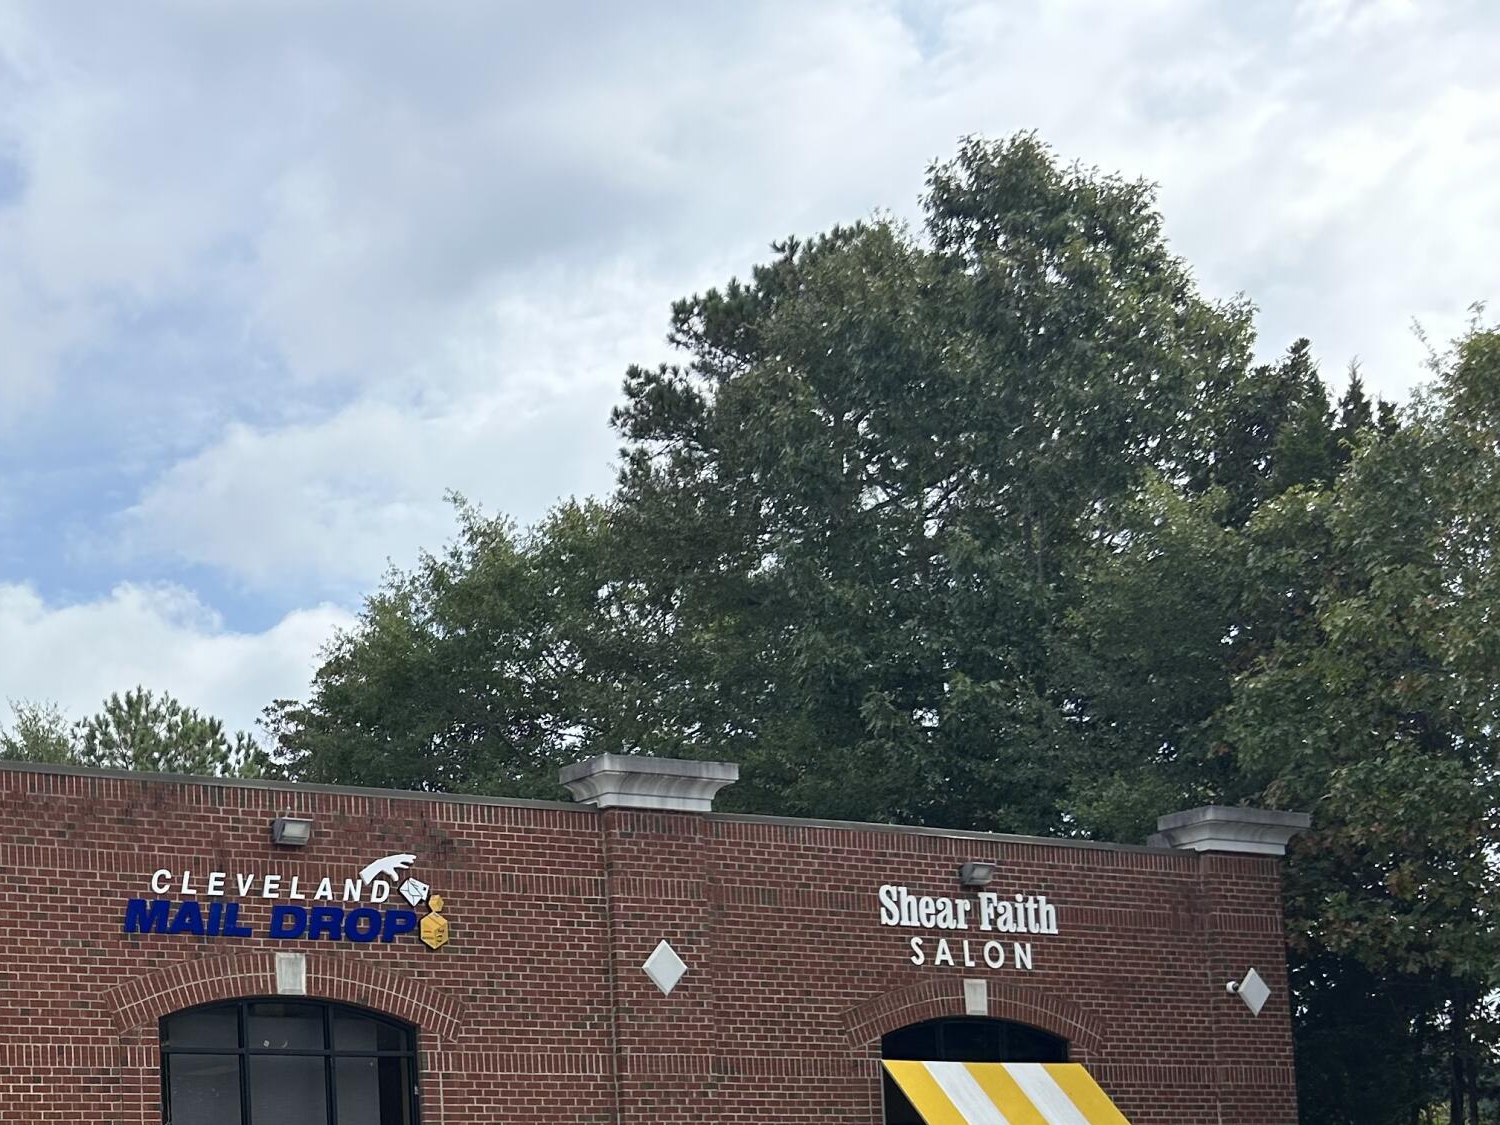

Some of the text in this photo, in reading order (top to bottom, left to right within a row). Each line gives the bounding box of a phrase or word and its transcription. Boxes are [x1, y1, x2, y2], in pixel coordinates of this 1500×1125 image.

[151, 868, 390, 904] CLEVELAND
[123, 898, 418, 943] MAIL DROP
[878, 884, 1059, 935] Shear Faith
[910, 936, 1033, 970] SALON
